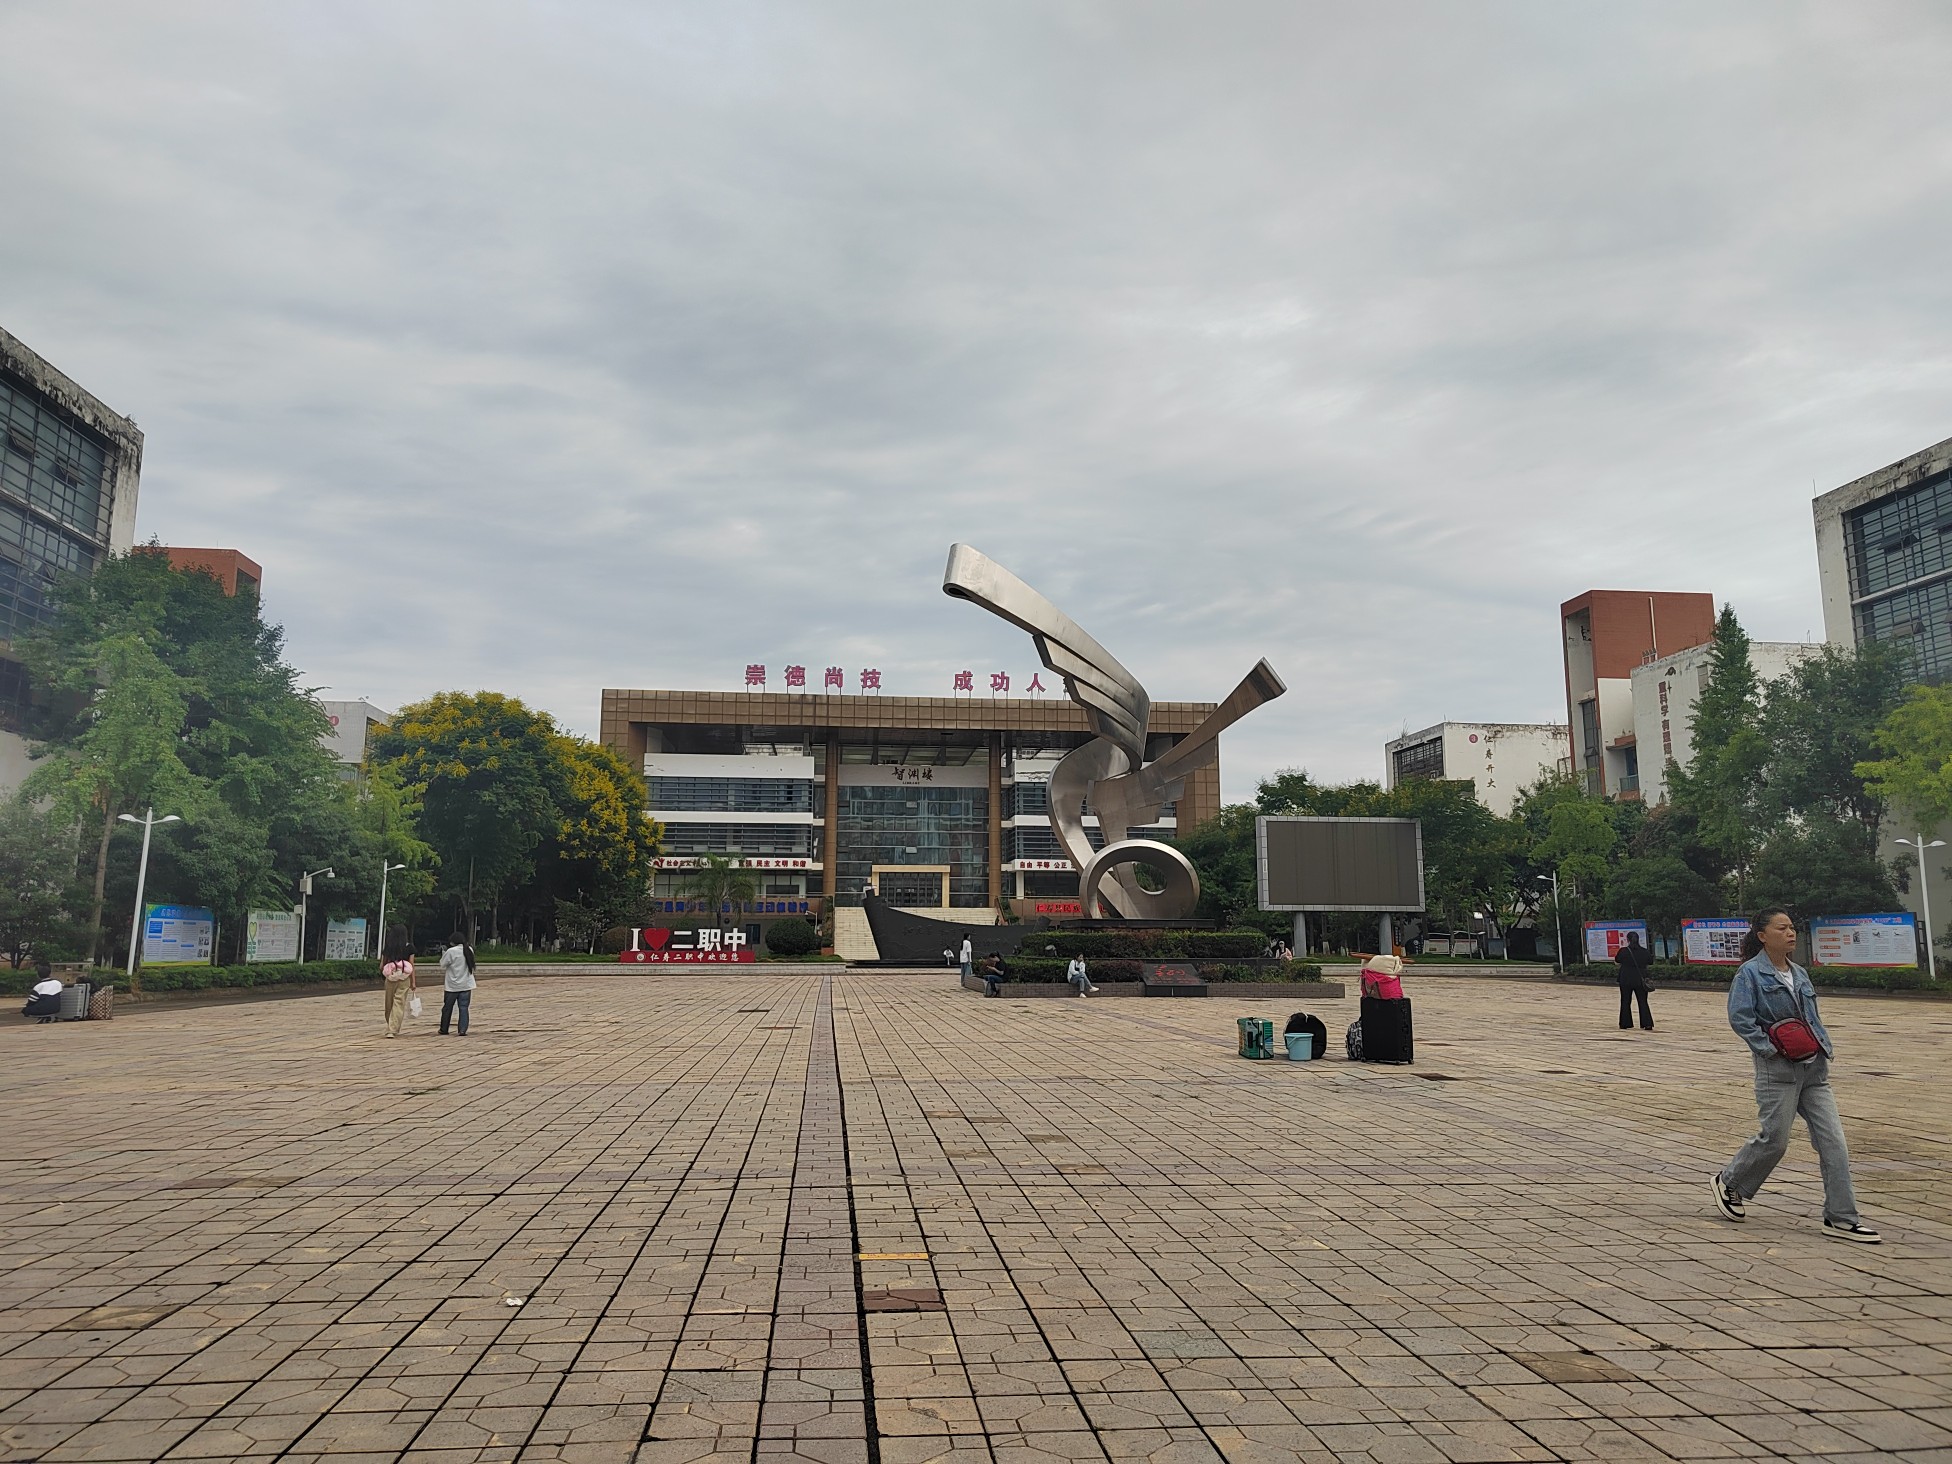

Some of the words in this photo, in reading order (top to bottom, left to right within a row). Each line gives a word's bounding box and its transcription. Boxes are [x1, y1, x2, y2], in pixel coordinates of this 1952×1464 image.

[745, 664, 882, 690] 崇德尚技
[953, 670, 1068, 693] 成功人
[756, 860, 771, 868] 民主
[774, 860, 789, 868] 文明
[792, 860, 806, 868] 和谐
[1020, 861, 1033, 869] 自由
[1036, 861, 1050, 869] 平等
[1053, 861, 1068, 869] 公正
[630, 928, 642, 952] I
[671, 927, 747, 952] 二职中
[650, 951, 740, 962] 仁寿二职中欢迎您
